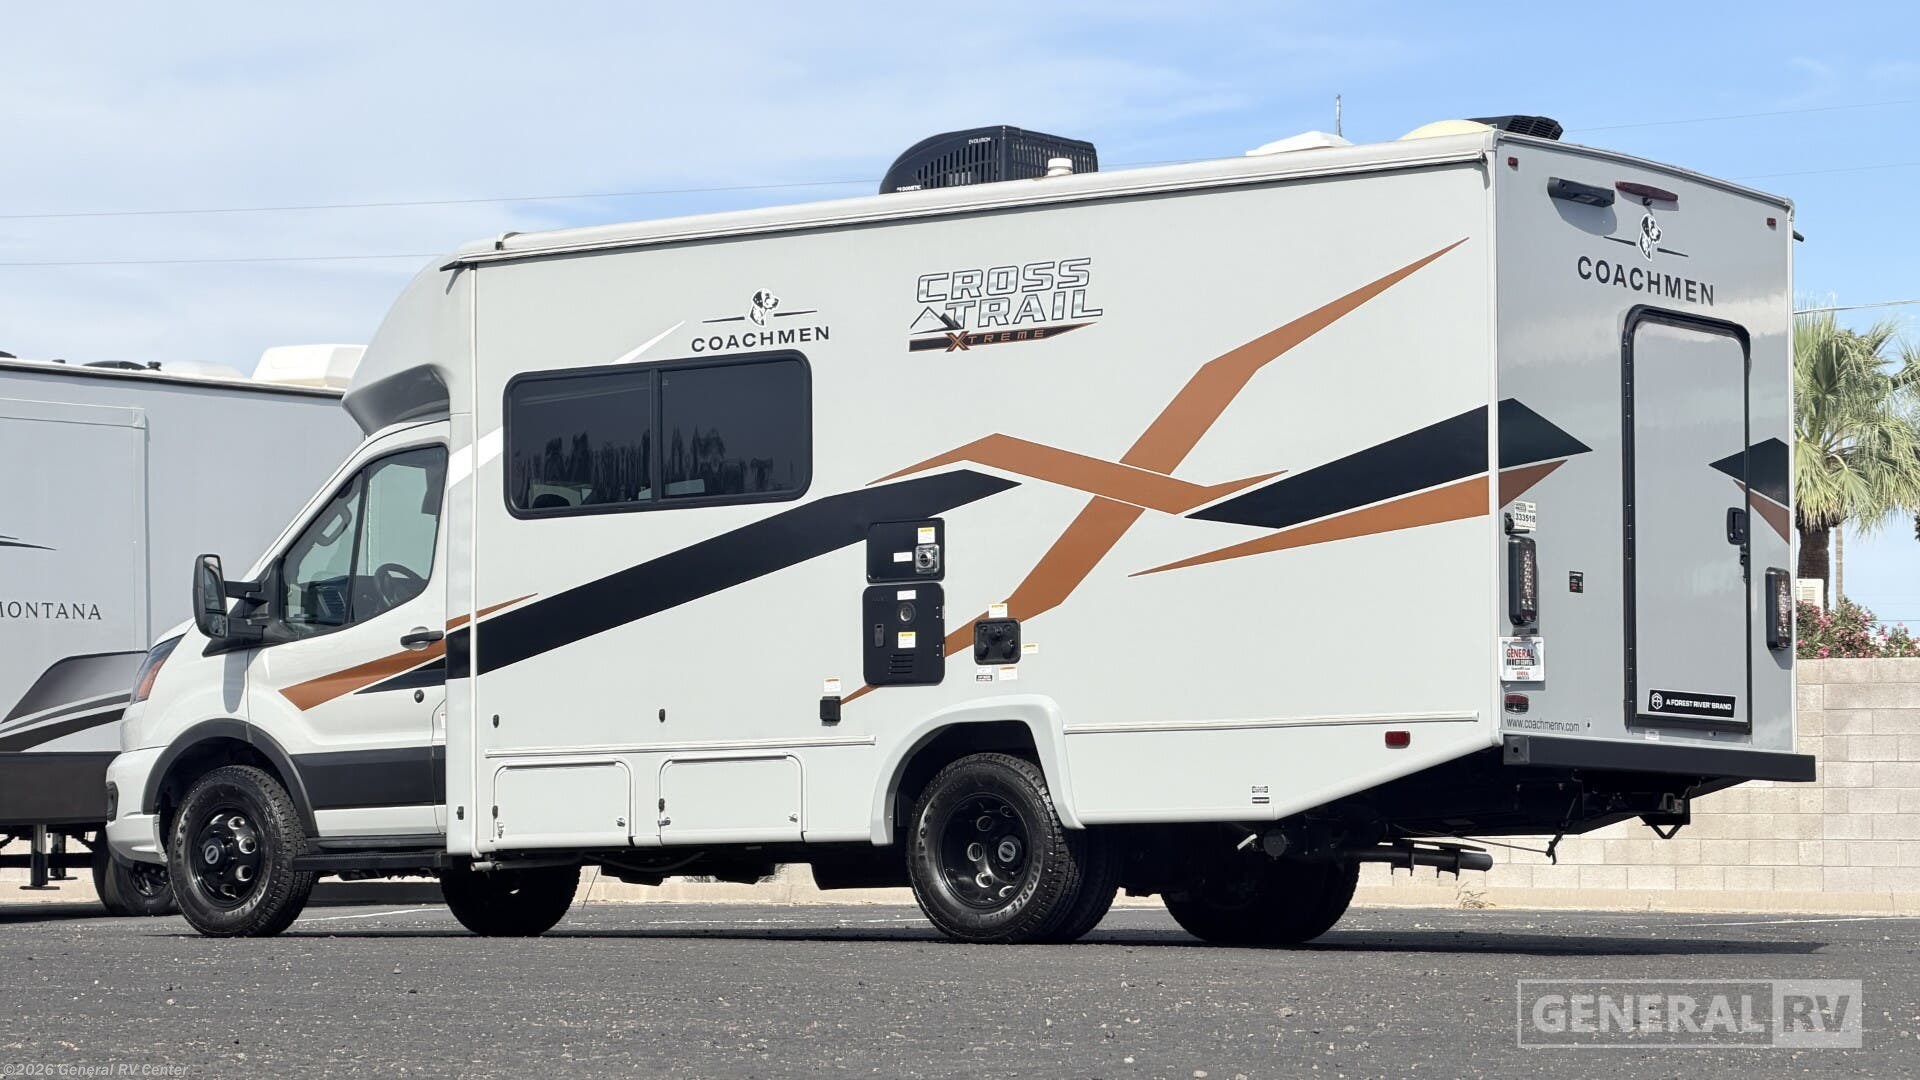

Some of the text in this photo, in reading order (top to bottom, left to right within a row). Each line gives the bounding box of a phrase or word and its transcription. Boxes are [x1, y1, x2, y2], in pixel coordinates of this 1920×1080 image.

[916, 257, 1091, 303] CROSS
[1577, 256, 1714, 305] COACHMEN
[945, 289, 1103, 329] TRAIL
[691, 326, 829, 352] COACHMEN
[945, 329, 1046, 352] XTREME
[0, 601, 101, 620] ONTANA
[1671, 699, 1693, 707] FOREST
[1506, 719, 1580, 732] www.coachmenrv.com
